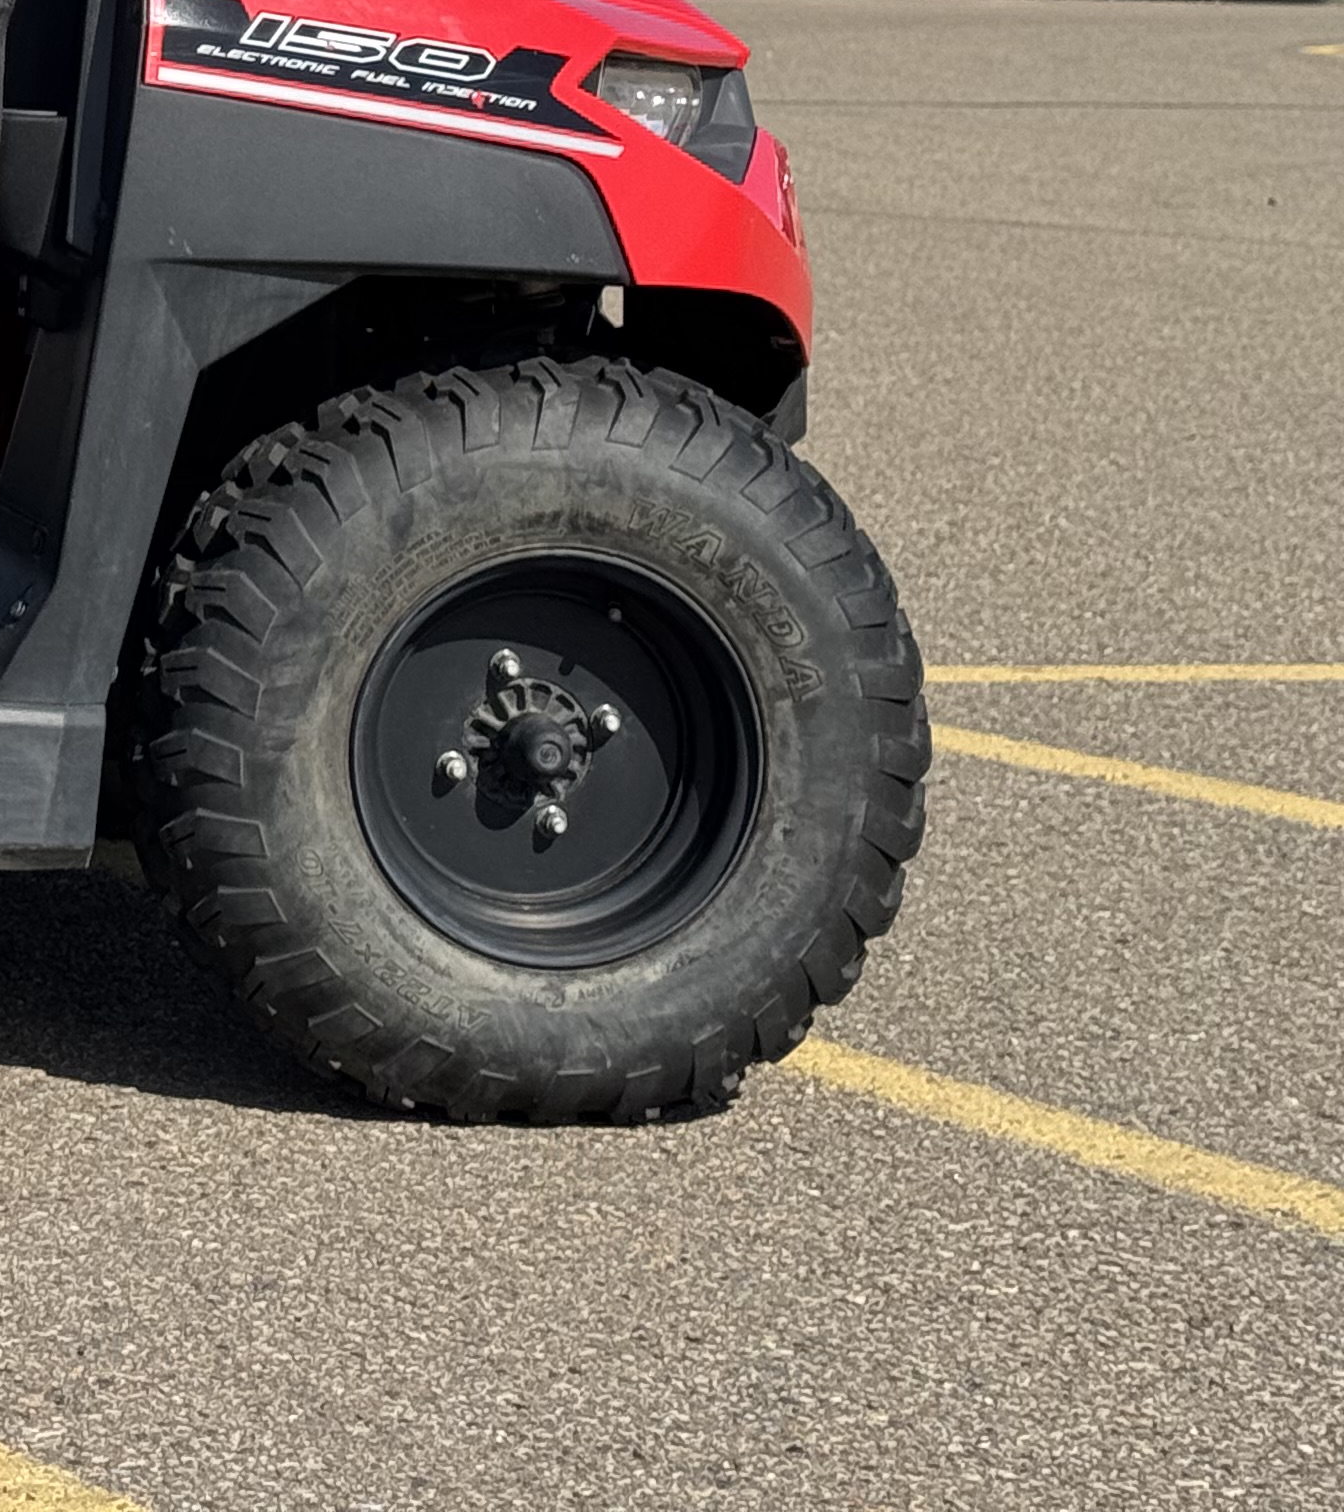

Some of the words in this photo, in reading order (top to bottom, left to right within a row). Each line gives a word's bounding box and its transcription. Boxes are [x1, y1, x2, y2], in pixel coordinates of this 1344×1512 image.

[196, 43, 341, 77] ELECTRONIC
[350, 68, 411, 89] FUEL
[239, 11, 497, 82] 150
[627, 498, 824, 704] WANDA
